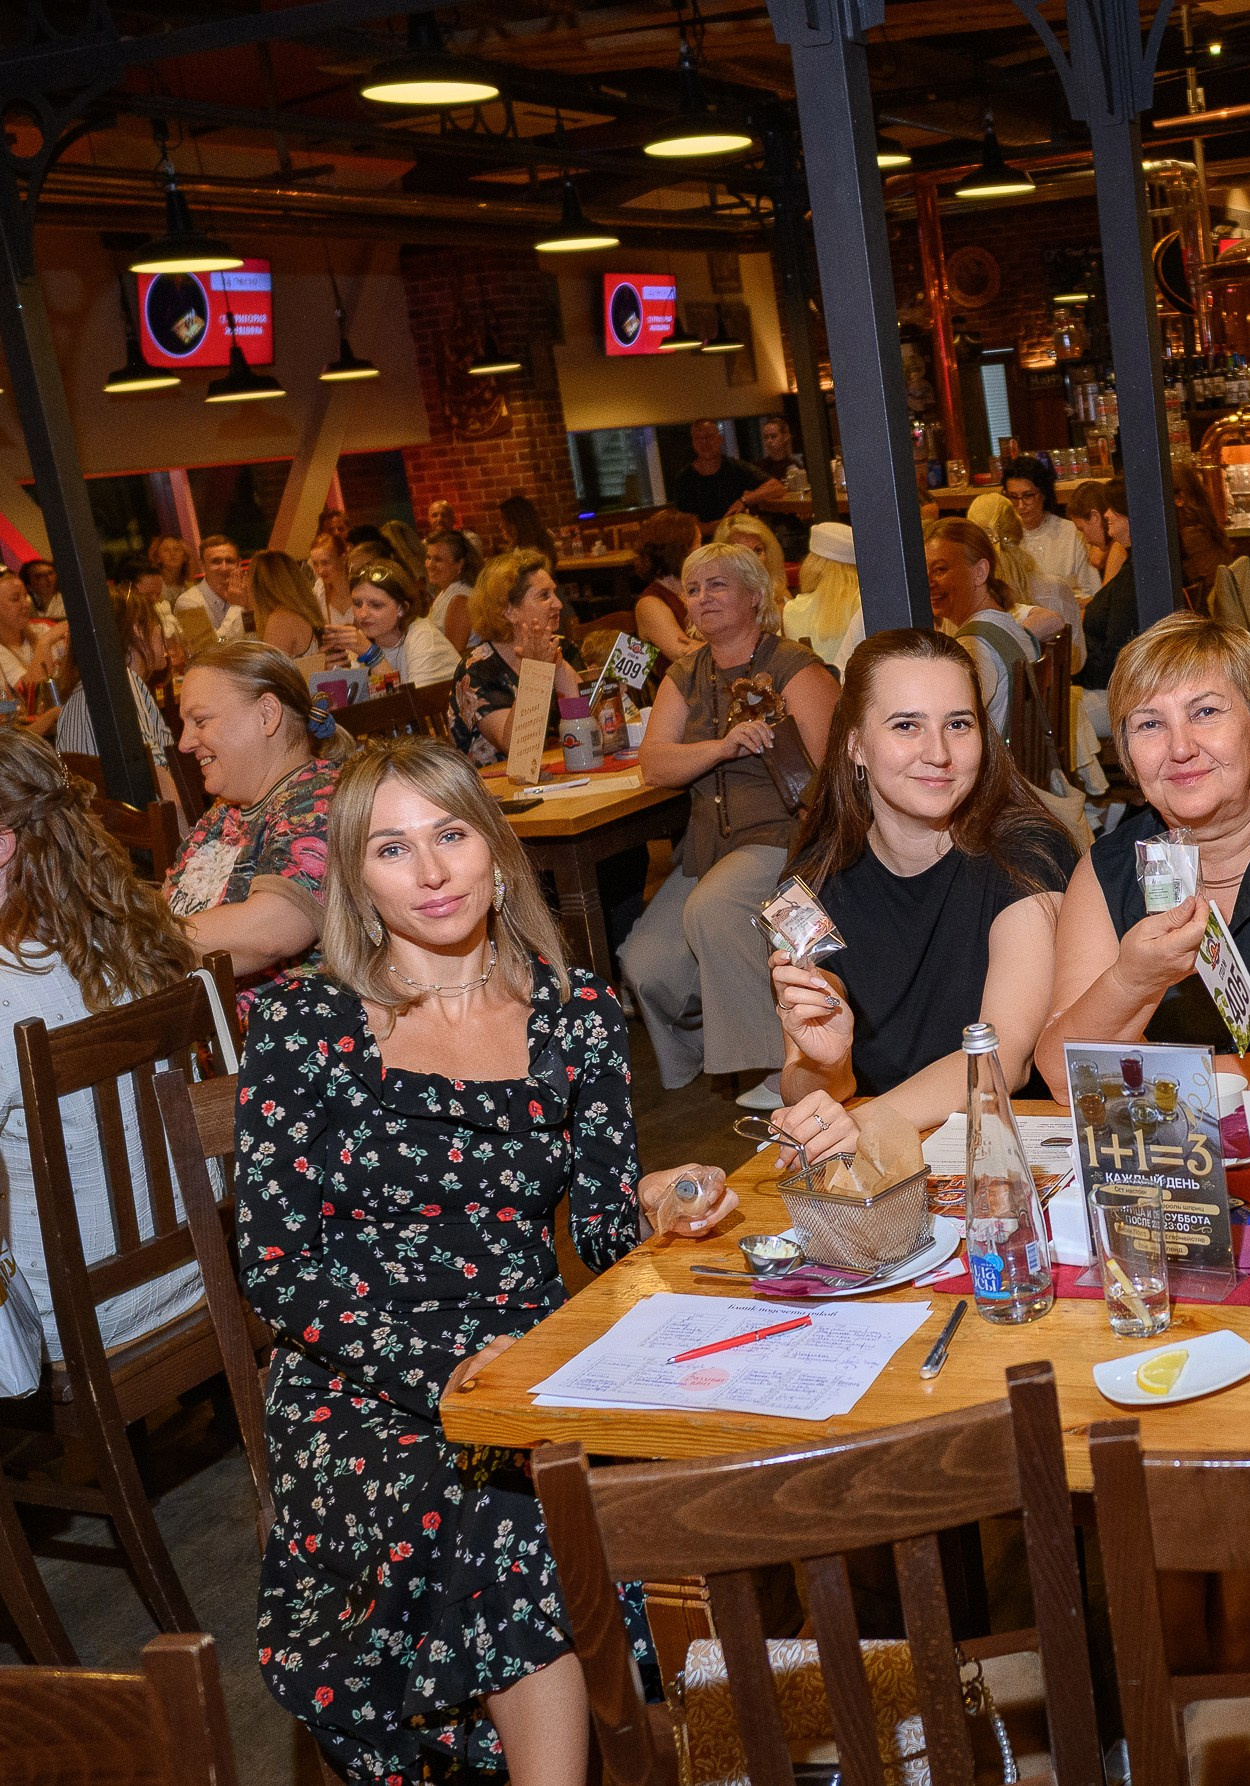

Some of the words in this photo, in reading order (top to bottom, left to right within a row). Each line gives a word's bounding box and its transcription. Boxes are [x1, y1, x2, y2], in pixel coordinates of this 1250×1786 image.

[615, 657, 642, 679] 409
[1224, 963, 1249, 1025] 405
[1084, 1125, 1213, 1176] 1+1=3
[1166, 1177, 1200, 1190] ДЕНЬ
[1125, 1215, 1151, 1228] ПОСЛЕ
[1164, 1212, 1211, 1225] СУББОТА
